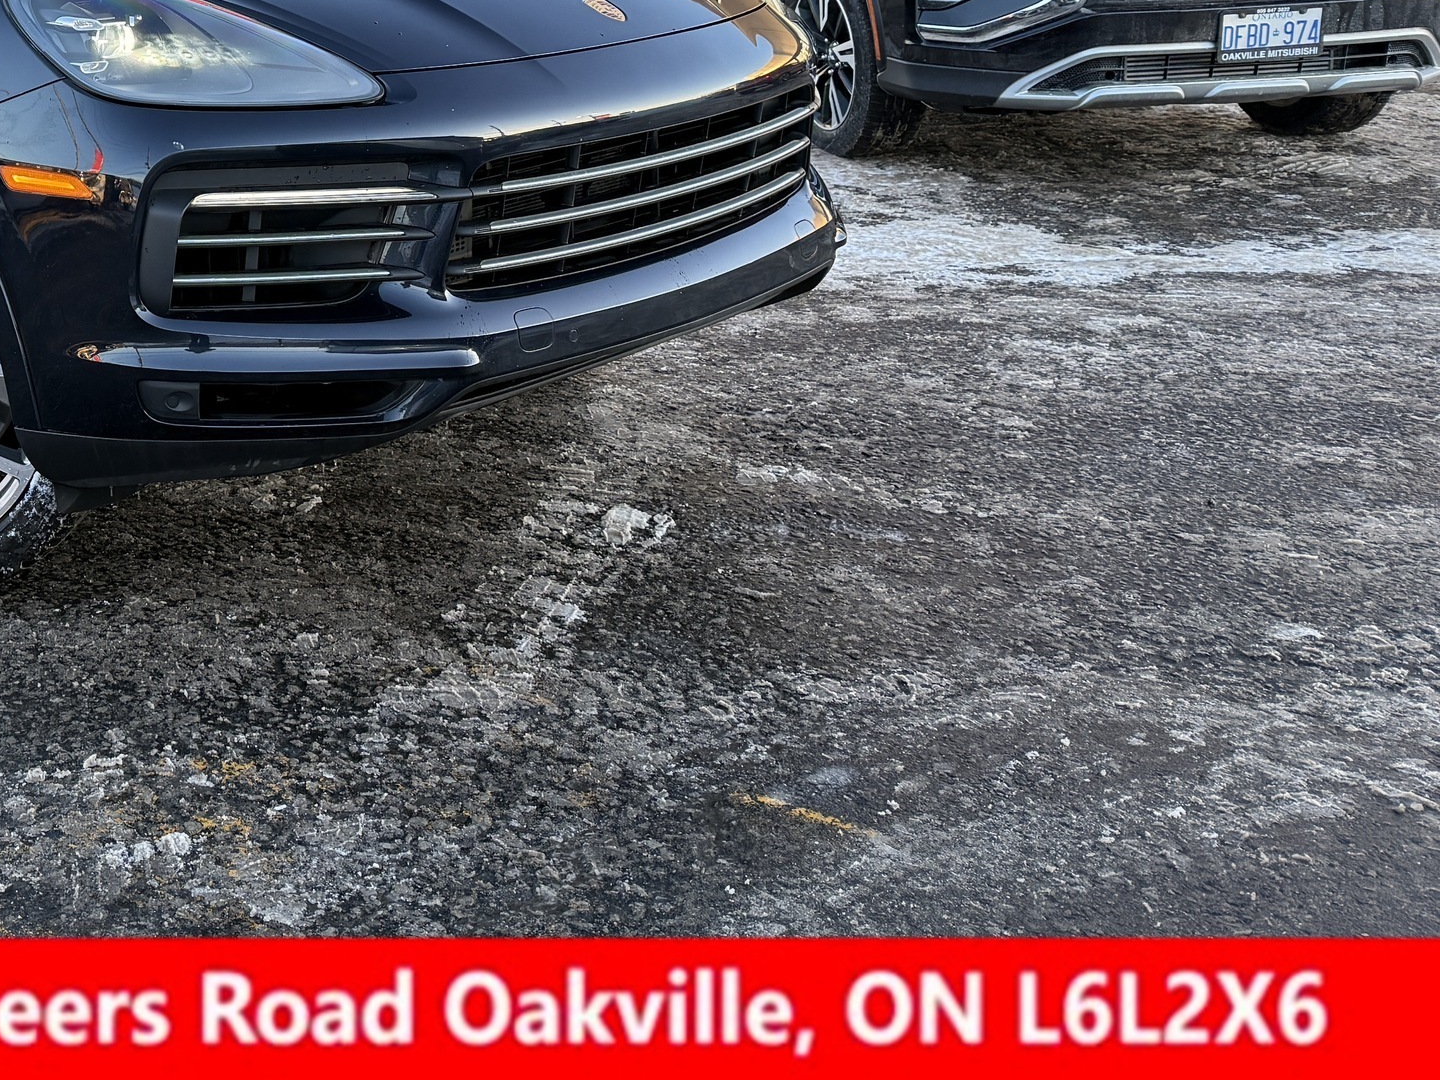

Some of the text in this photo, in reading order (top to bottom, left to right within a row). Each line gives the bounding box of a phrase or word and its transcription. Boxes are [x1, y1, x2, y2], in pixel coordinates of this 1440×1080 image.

[1223, 19, 1319, 50] DFBD 974
[1221, 46, 1318, 61] OAKVILLE MITSUBISHI
